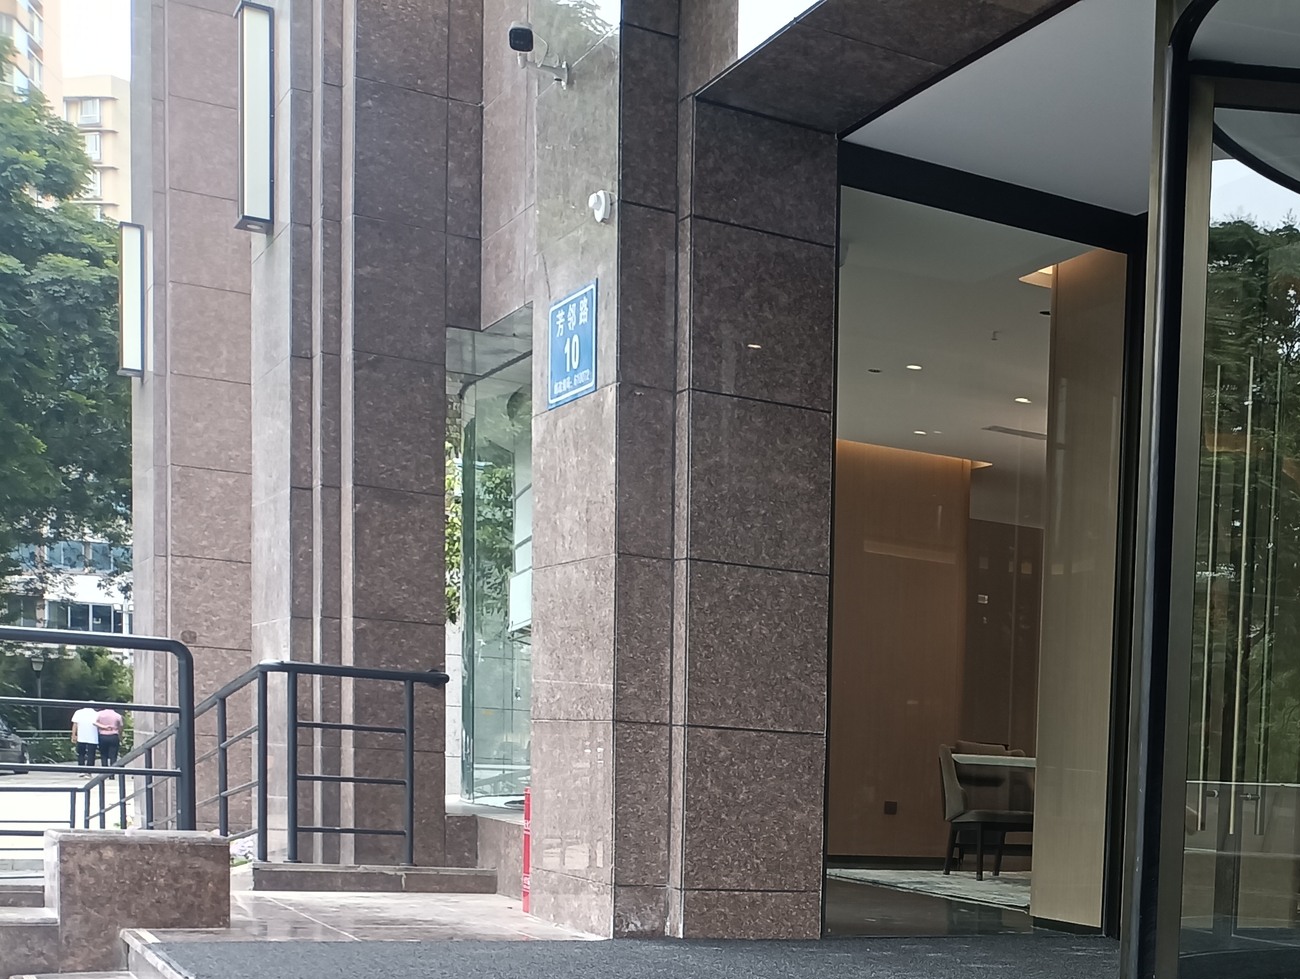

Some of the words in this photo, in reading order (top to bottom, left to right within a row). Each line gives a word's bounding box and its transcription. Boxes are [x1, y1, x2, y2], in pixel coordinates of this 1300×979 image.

[556, 297, 588, 337] 芳邻路
[564, 334, 579, 372] 10
